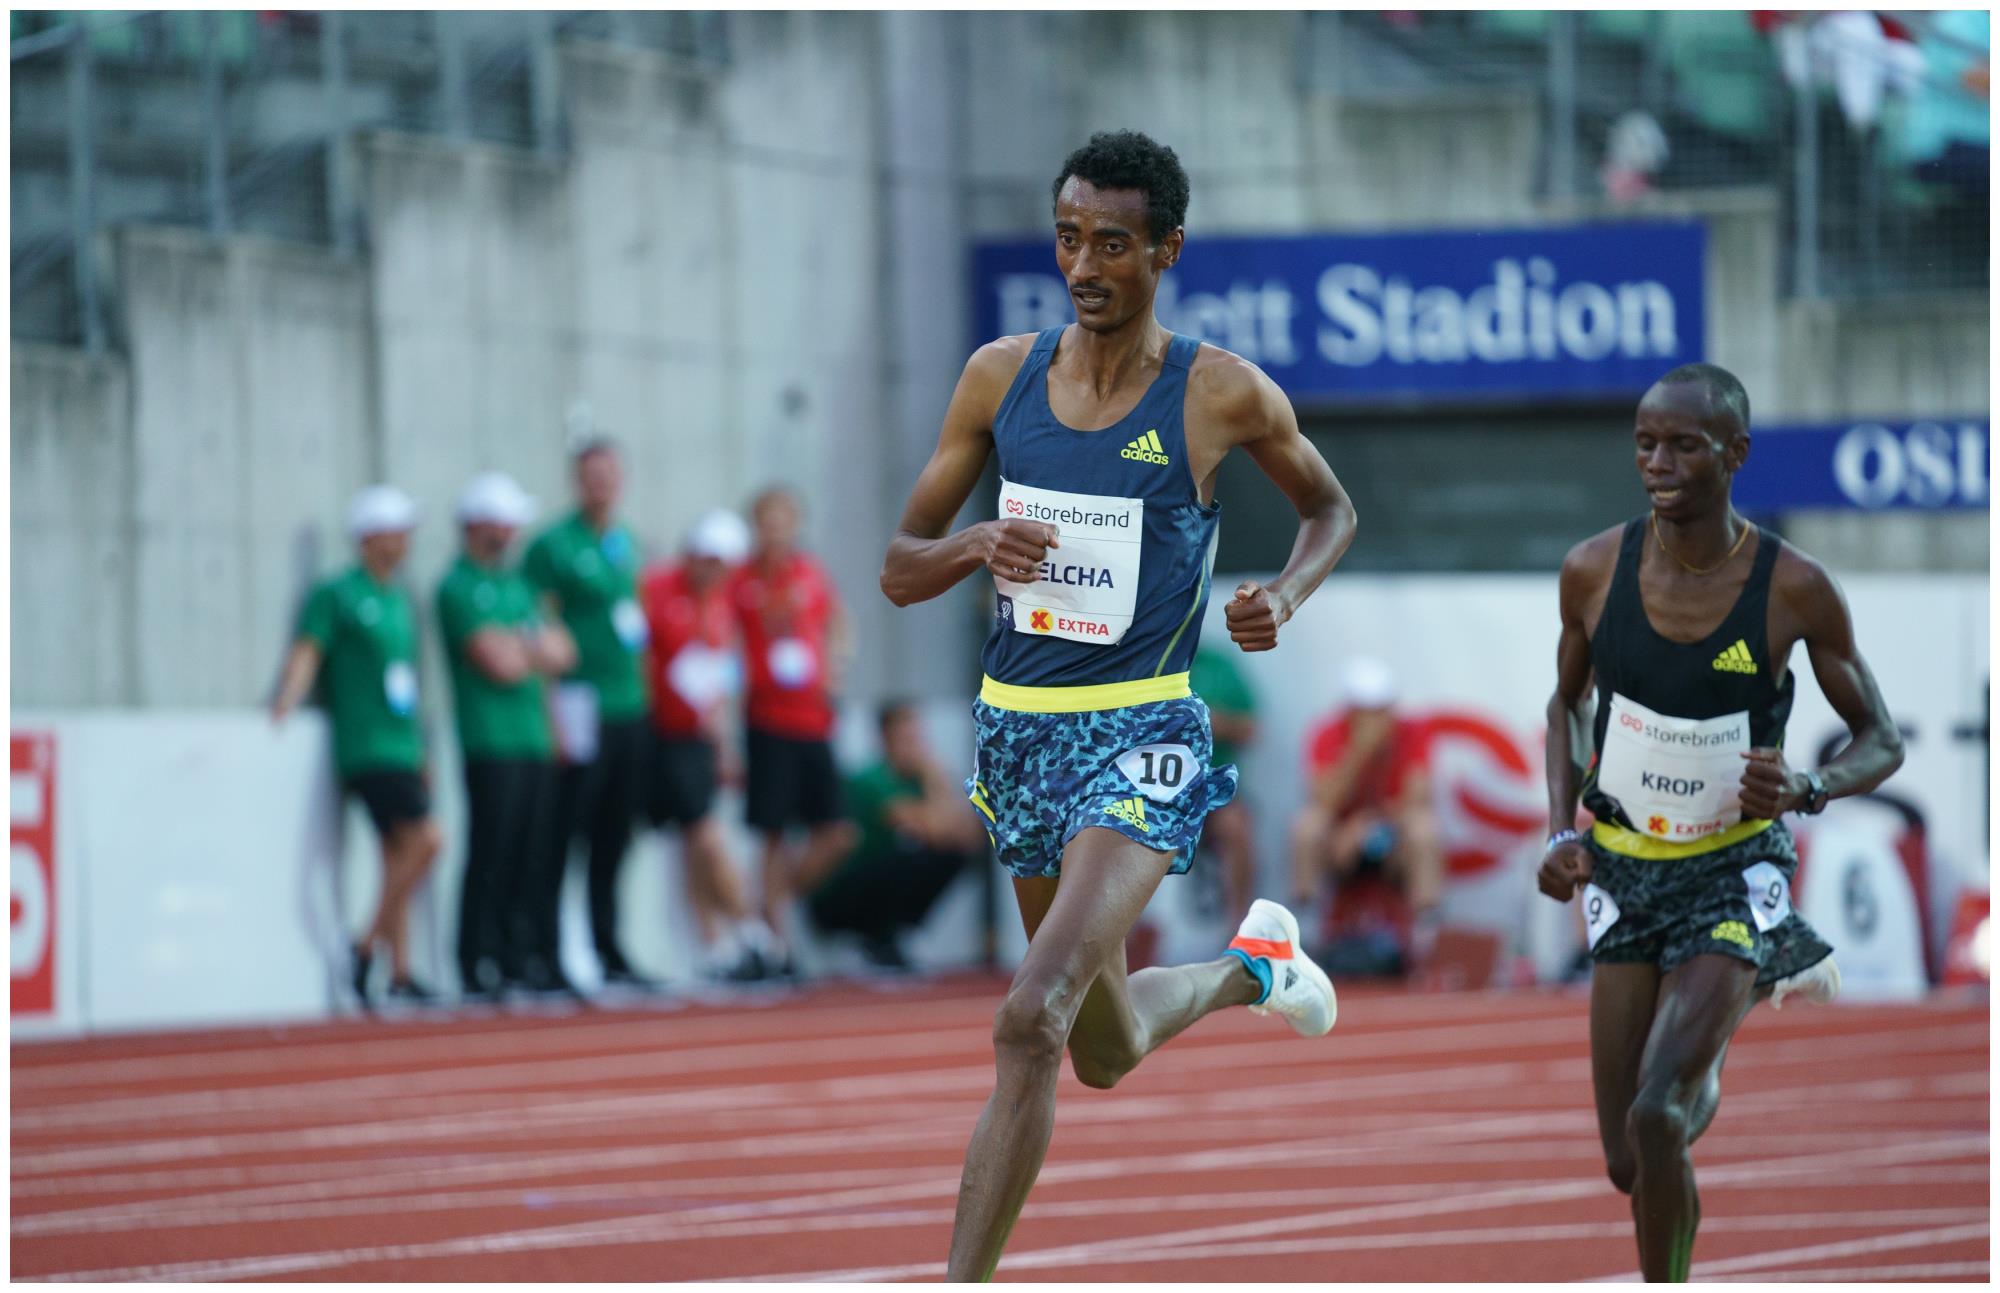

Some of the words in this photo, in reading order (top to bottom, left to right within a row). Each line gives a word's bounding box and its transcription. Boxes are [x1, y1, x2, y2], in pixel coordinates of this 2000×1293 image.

[1316, 257, 1680, 368] Stadion
[1120, 447, 1169, 466] adidas
[1026, 502, 1130, 528] storebrand
[1039, 561, 1114, 589] ELCHA
[1058, 617, 1110, 636] EXTRA
[1712, 657, 1757, 675] adidas
[1644, 724, 1741, 747] storebrand
[1138, 752, 1184, 788] 10
[1641, 770, 1705, 797] KROP
[1103, 805, 1150, 833] adidas
[1588, 896, 1602, 925] 9
